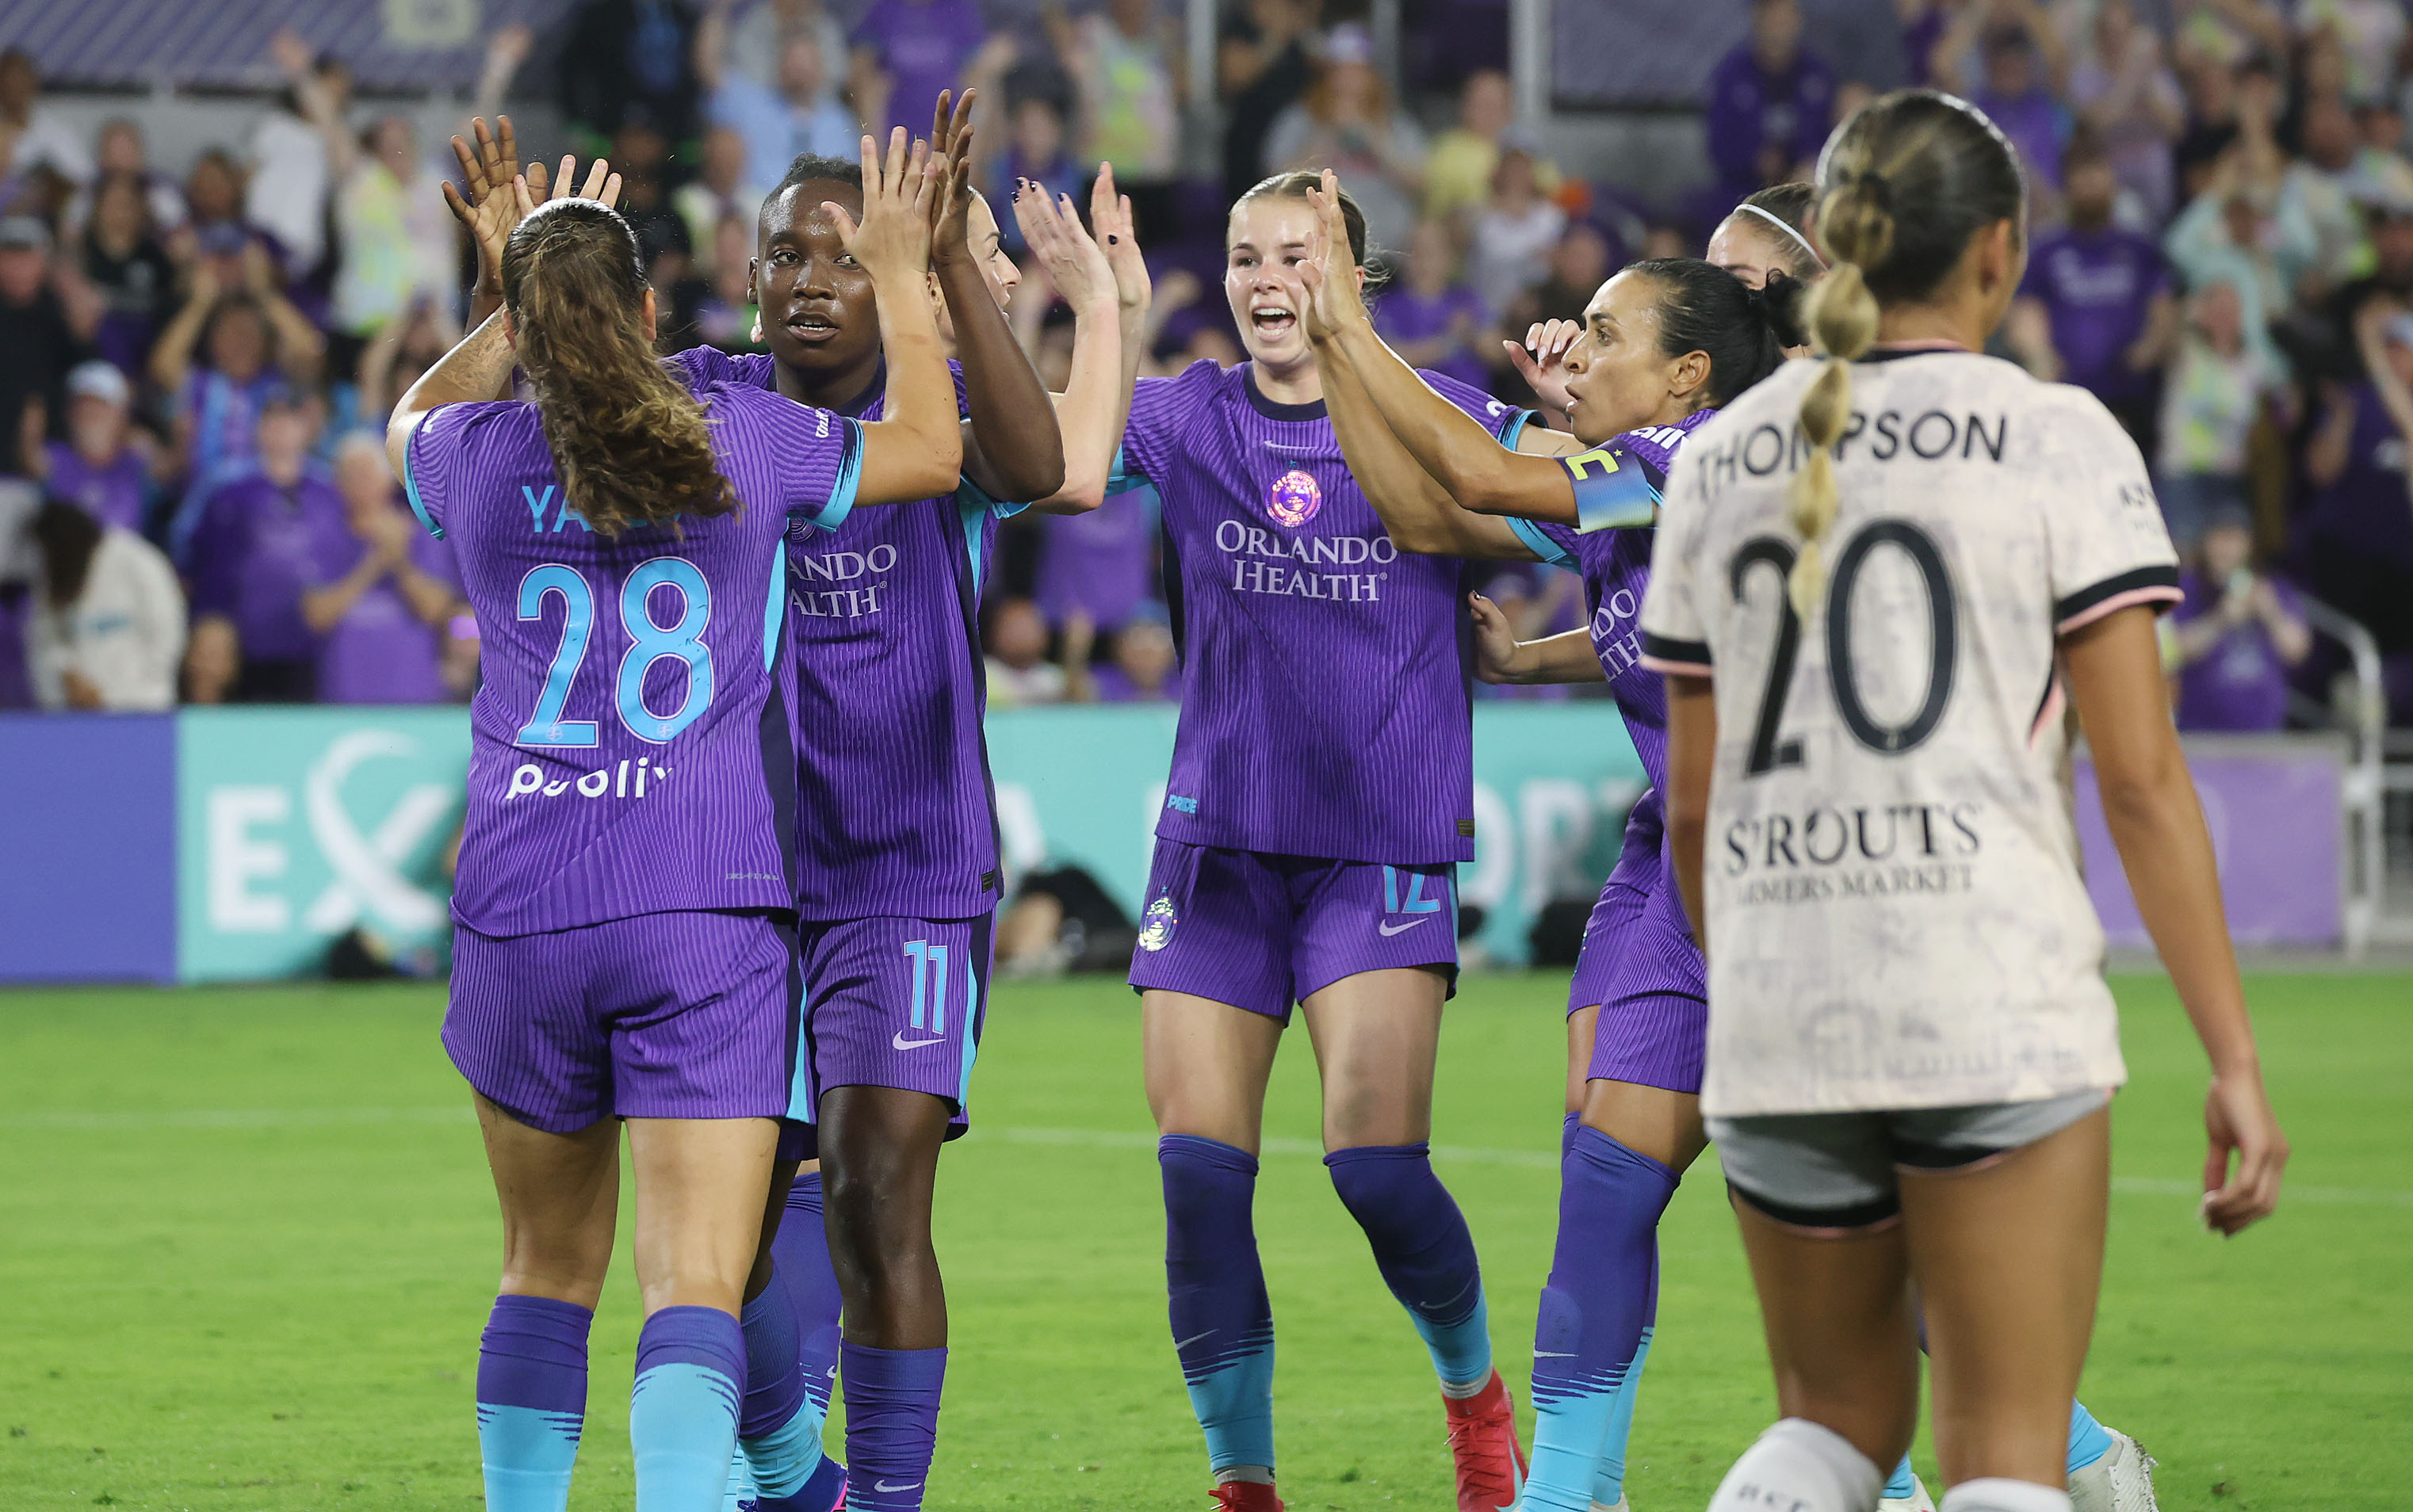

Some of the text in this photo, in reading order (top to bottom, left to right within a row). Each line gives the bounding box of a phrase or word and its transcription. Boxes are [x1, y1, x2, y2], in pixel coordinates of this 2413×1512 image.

[1215, 520, 1398, 565] ORLANDO
[513, 556, 715, 749] 28
[1729, 517, 1960, 777] 20
[1724, 804, 1981, 875] SROUTS
[904, 939, 948, 1036] 11
